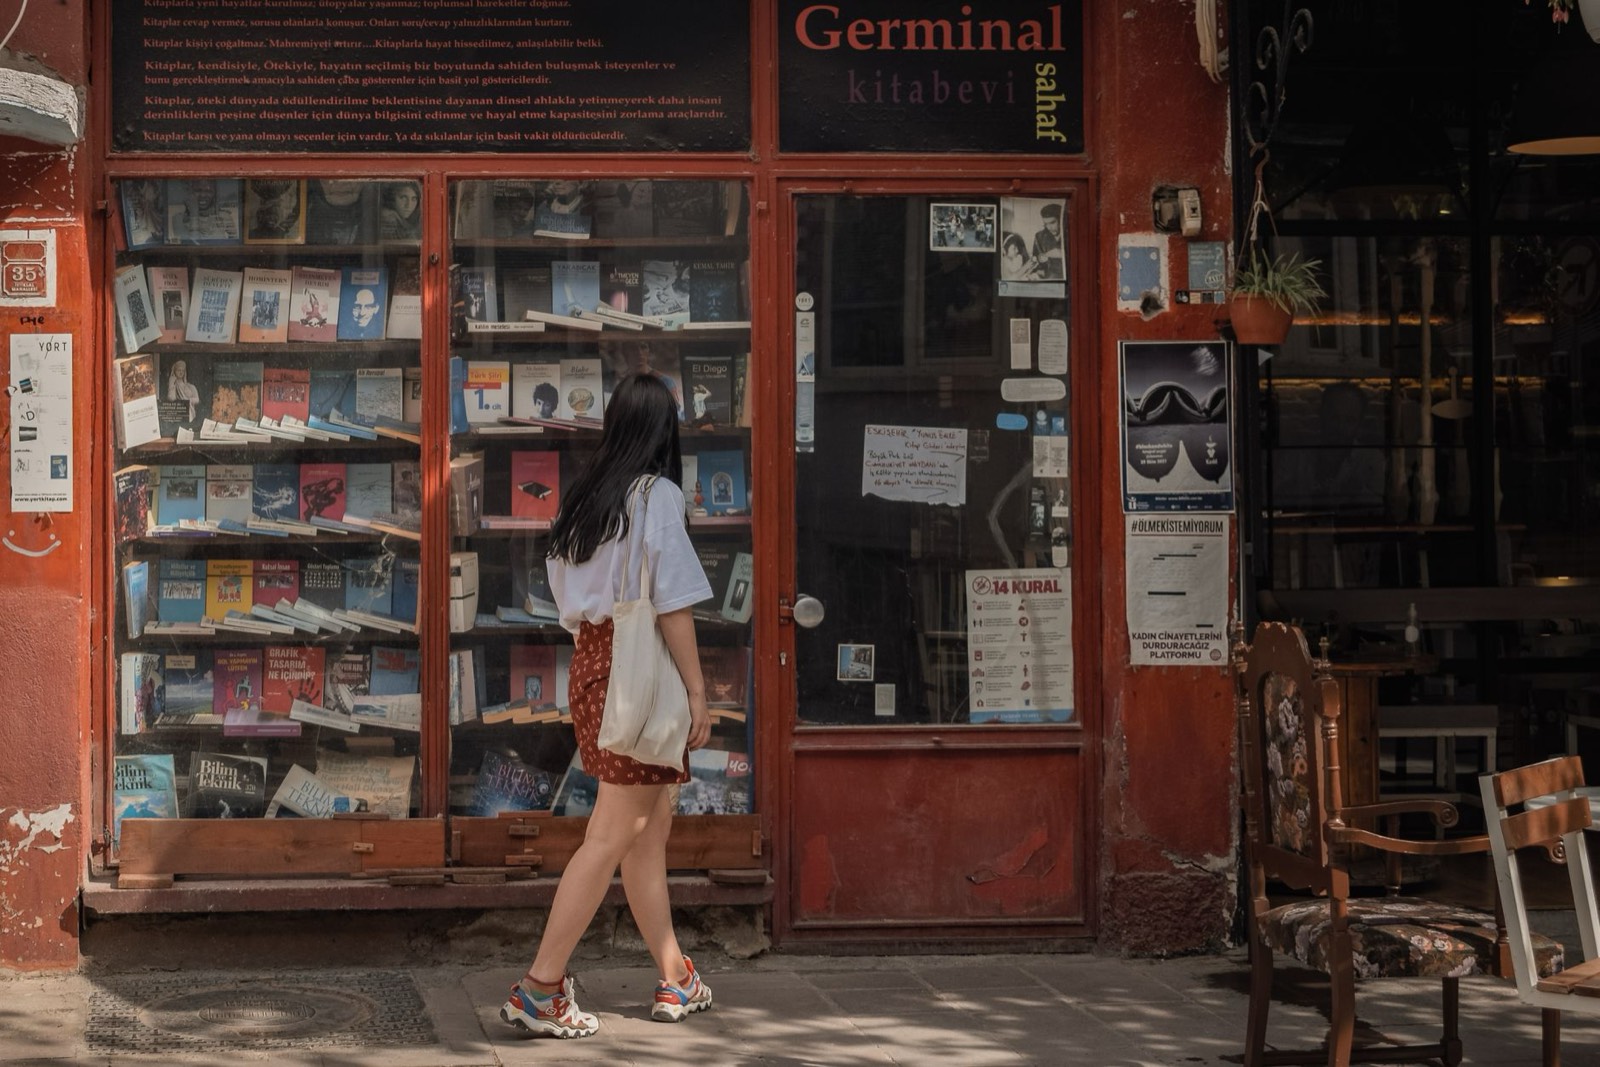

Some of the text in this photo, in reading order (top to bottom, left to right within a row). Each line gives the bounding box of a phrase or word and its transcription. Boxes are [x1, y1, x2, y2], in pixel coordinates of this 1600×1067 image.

[143, 18, 181, 29] Kitaplar
[182, 20, 210, 29] cevap
[212, 20, 248, 29] vermez,
[283, 18, 324, 26] olanlarla
[326, 18, 367, 29] konuşur.
[369, 18, 399, 26] Onları
[401, 18, 450, 29] soru/cevap
[534, 18, 572, 26] kurtarır.
[795, 5, 1066, 51] Germinal
[144, 39, 183, 50] Kitaplar
[186, 39, 213, 50] kişiyi
[215, 39, 266, 50] çoğaltmaz.
[270, 39, 332, 50] Mahremiyeti
[425, 39, 451, 50] hayat
[454, 39, 514, 50] hissedilmez,
[516, 39, 573, 50] anlaşılabilir
[576, 39, 604, 48] belki.
[145, 61, 195, 72] Kitaplar,
[198, 61, 260, 72] kendisiyle,
[264, 60, 316, 72] Ötekiyle,
[320, 61, 362, 72] hayatın
[365, 61, 411, 72] seçilmiş
[414, 61, 430, 70] bir
[434, 61, 495, 72] boyutunda
[498, 61, 542, 70] sahiden
[545, 61, 602, 72] buluşmak
[605, 61, 660, 72] isteyenler
[144, 75, 552, 86] bunu gerçekleştirmek amacıyla sahiden çaba gösterenler için basit yol göstericilerdir.
[848, 68, 1015, 104] kitabevi
[144, 96, 194, 107] Kitaplar,
[197, 96, 226, 105] öteki
[229, 96, 278, 107] dünyada
[372, 96, 442, 105] beklentisine
[445, 96, 493, 107] dayanan
[496, 96, 531, 105] dinsel
[534, 96, 575, 105] ahlakla
[578, 96, 655, 107] yetinmeyerek
[658, 96, 684, 105] daha
[688, 96, 722, 105] insani
[1035, 62, 1067, 143] sahaf
[144, 110, 216, 119] derinliklerin
[219, 110, 256, 122] peşine
[259, 110, 308, 122] düşenler
[312, 110, 333, 122] için
[336, 110, 371, 122] dünya
[374, 110, 422, 122] bilgisini
[425, 110, 467, 119] edinme
[486, 110, 516, 122] hayal
[519, 110, 546, 119] etme
[549, 110, 616, 122] kapasitesini
[620, 110, 664, 119] zorlama
[667, 110, 727, 122] araçlarıdır.
[143, 132, 186, 143] Kitaplar
[188, 132, 213, 143] karşı
[229, 134, 253, 143] yana
[256, 132, 290, 143] olmayı
[293, 132, 334, 143] seçenler
[337, 132, 355, 143] için
[358, 132, 393, 141] vardır.
[395, 132, 408, 141] Ya
[410, 132, 423, 141] da
[425, 132, 472, 141] sıkılanlar
[475, 132, 494, 143] için
[497, 132, 520, 141] basit
[523, 132, 549, 141] vakit
[12, 266, 37, 282] 35
[692, 364, 728, 375] El Diego
[1131, 520, 1224, 533] #ÖLMEKİSTEMİYORUM
[993, 580, 1062, 594] 14 KURAL
[1132, 631, 1222, 641] KADIN CİNAYETLERİNİ
[1142, 640, 1210, 650] DURDURACAĞIZ
[269, 648, 298, 658] GRAFİK
[1150, 650, 1202, 659] PLATFORMU
[269, 659, 306, 668] TASARIM
[268, 670, 316, 682] NE İÇİNDİR?
[200, 760, 238, 776] Bilim
[115, 778, 153, 791] eknik
[196, 773, 242, 791] Teknik
